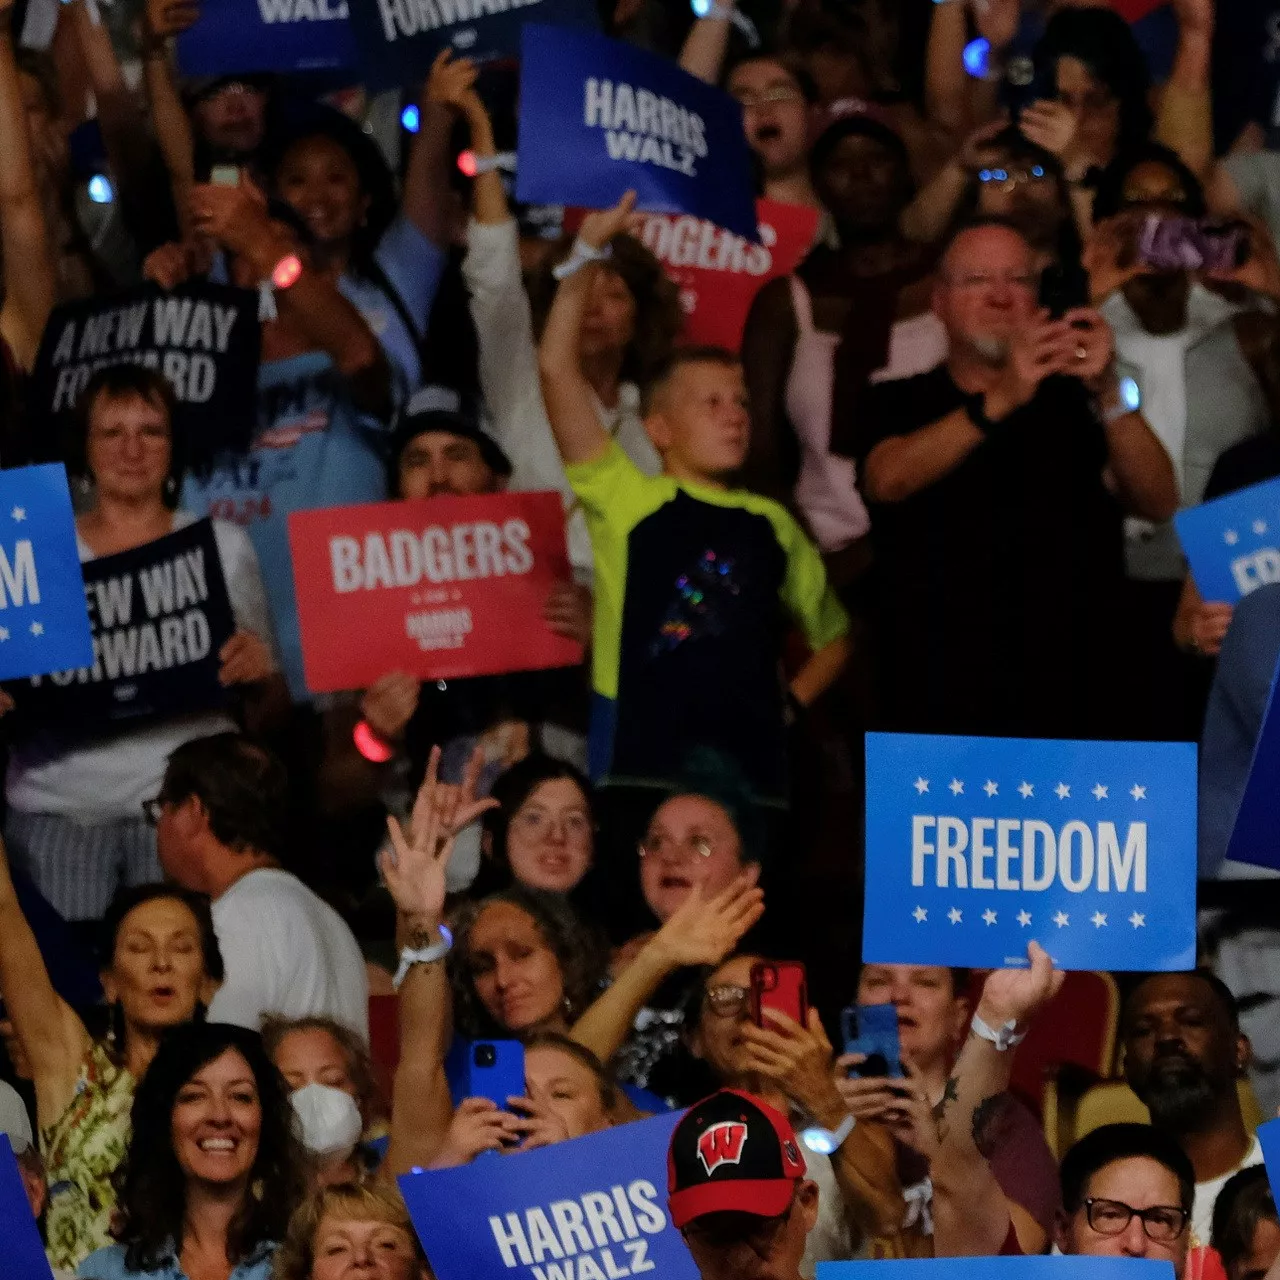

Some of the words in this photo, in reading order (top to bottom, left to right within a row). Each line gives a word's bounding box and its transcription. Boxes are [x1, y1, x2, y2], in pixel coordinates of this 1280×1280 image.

[585, 77, 708, 157] HARRIS
[606, 130, 697, 177] WALZ
[52, 319, 76, 366] A
[79, 301, 148, 357] NEW
[153, 297, 238, 351] WAY
[140, 547, 208, 619] WAY
[330, 518, 534, 593] BADGERS
[911, 816, 1148, 893] FREEDOM
[490, 1178, 666, 1268] HARRIS
